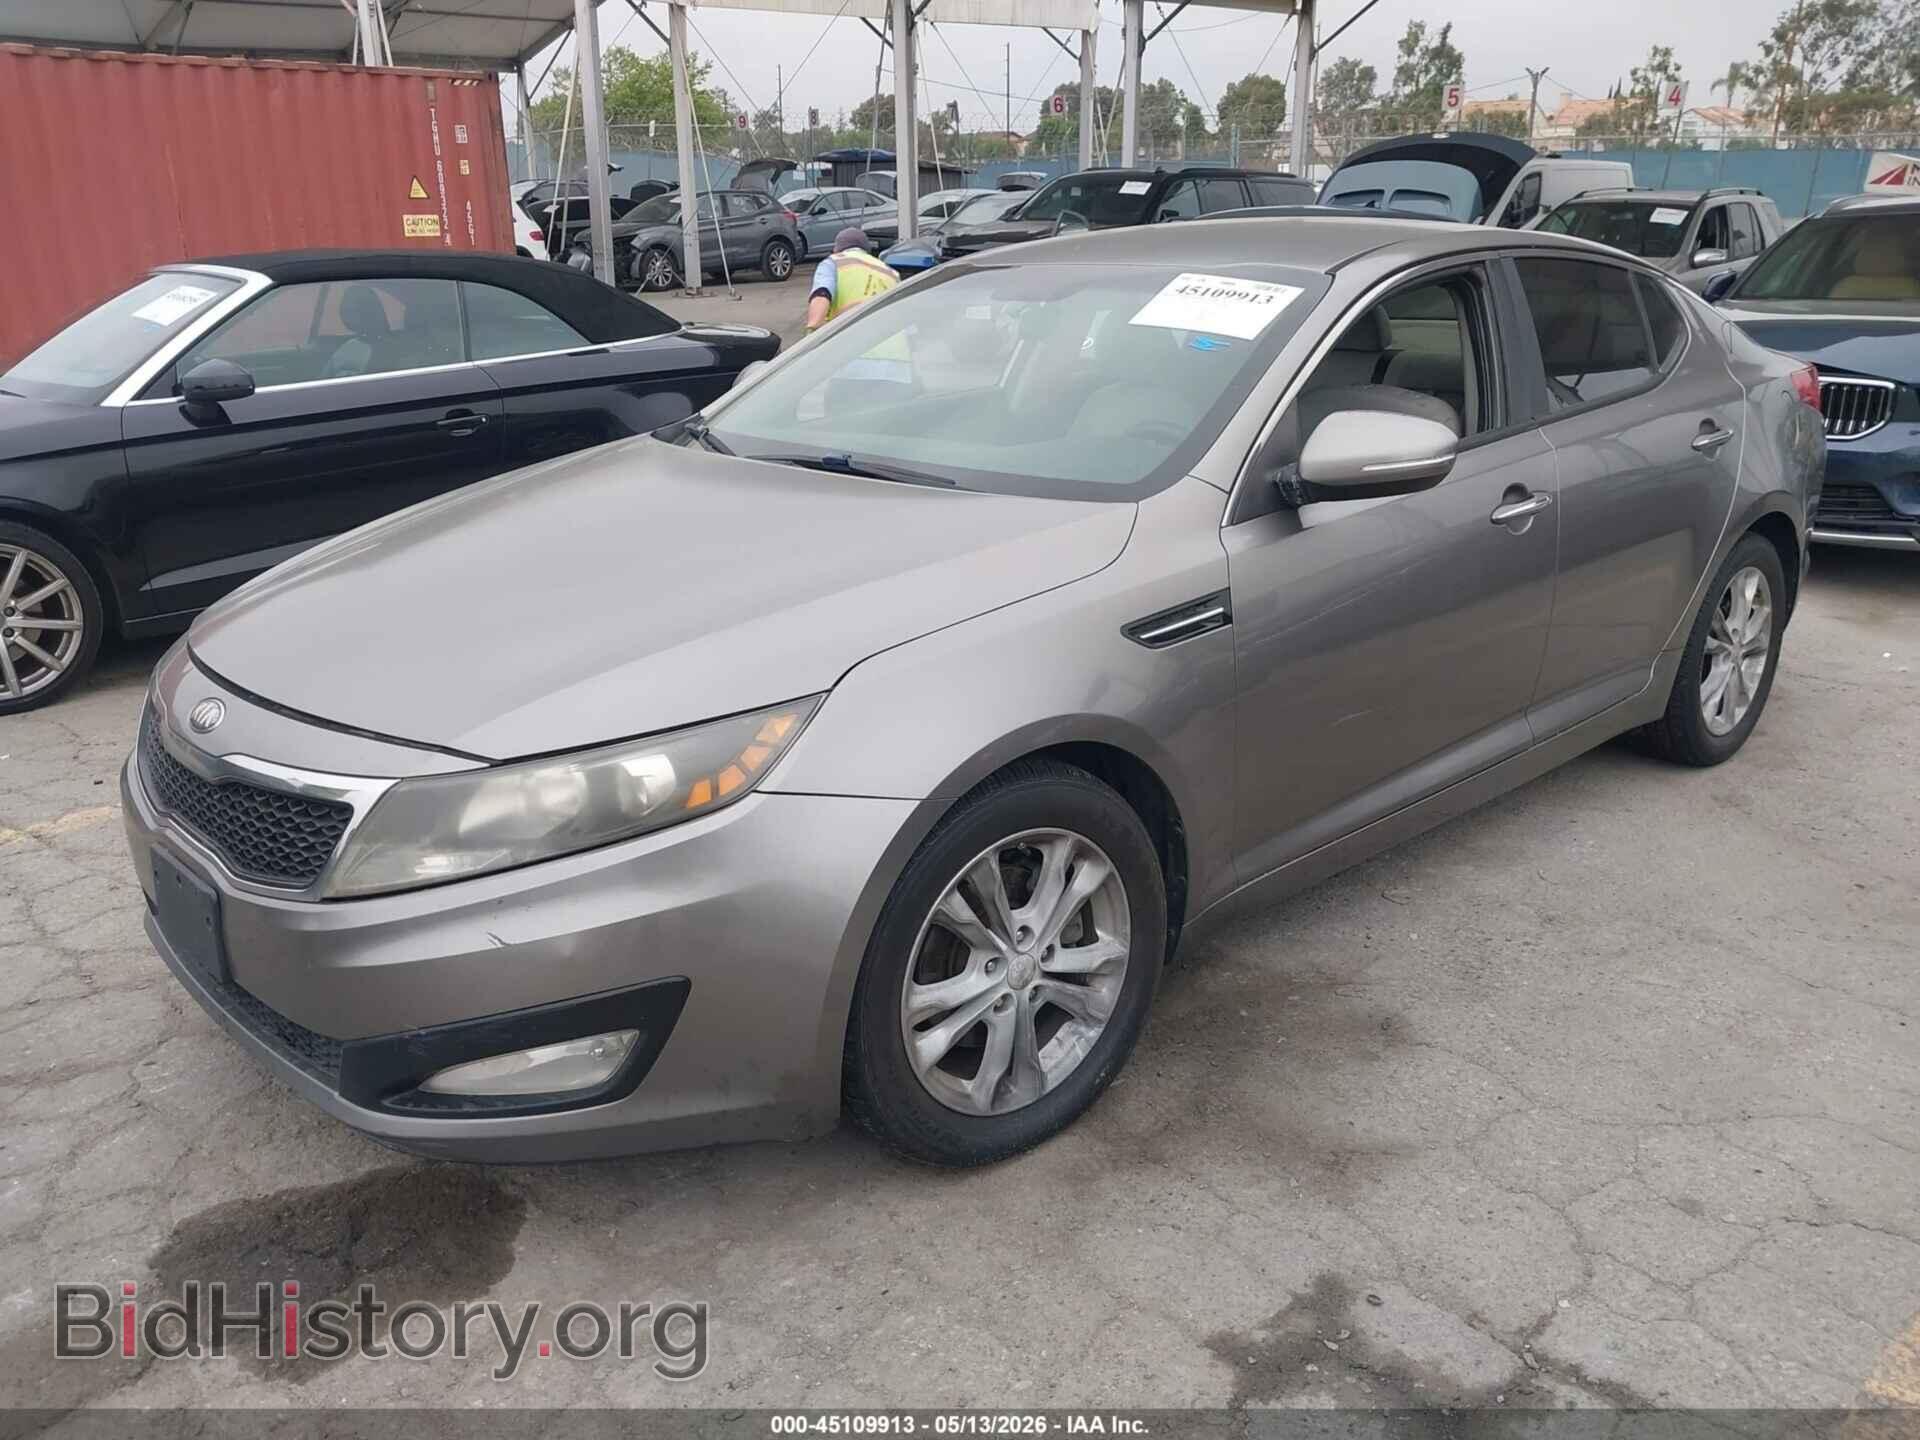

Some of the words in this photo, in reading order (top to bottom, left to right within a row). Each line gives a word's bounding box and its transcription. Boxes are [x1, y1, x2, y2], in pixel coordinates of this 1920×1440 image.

[1054, 91, 1064, 113] 6
[1447, 88, 1460, 108] 5
[1668, 85, 1680, 107] 4
[738, 115, 747, 129] 9
[405, 217, 439, 227] CAUTION
[466, 200, 475, 246] 45G1
[1176, 285, 1274, 304] 45109913
